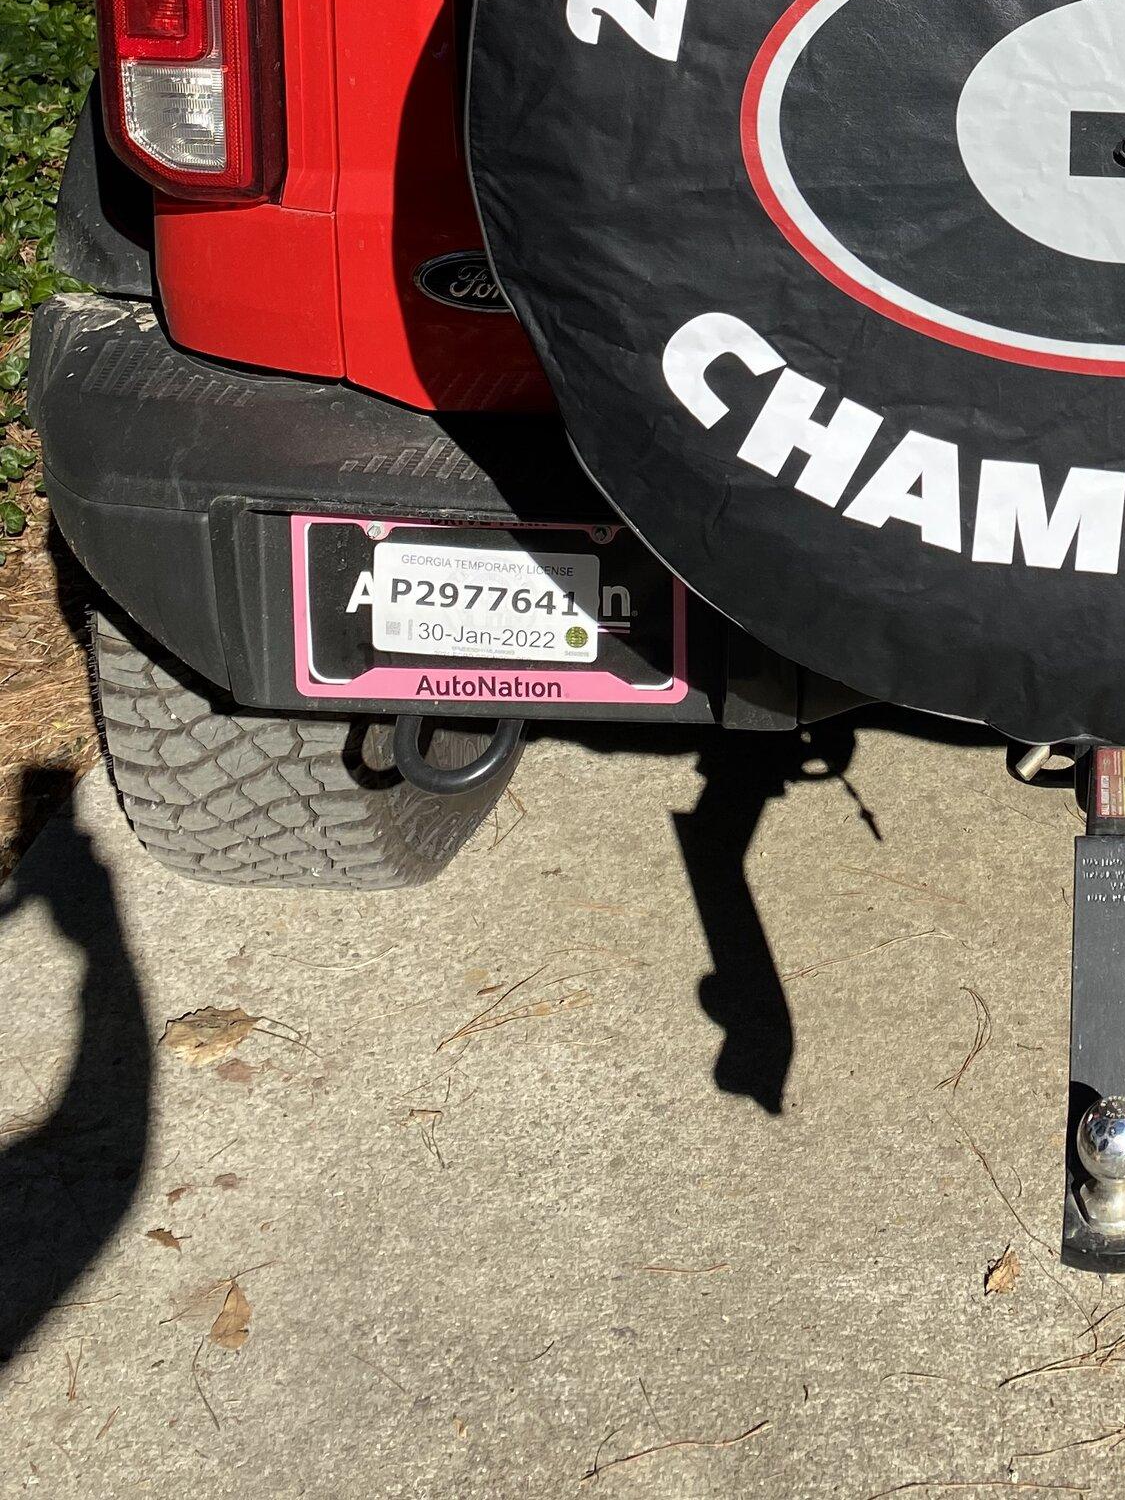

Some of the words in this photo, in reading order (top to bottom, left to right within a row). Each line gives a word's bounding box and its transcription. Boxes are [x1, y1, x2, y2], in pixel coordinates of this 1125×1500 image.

[401, 553, 451, 568] GEORGIA
[455, 559, 524, 575] TEMPORARY
[526, 564, 574, 577] LICENSE
[390, 577, 579, 617] P2977641
[418, 621, 556, 649] 30-Jan-2022
[415, 674, 562, 698] AutoNation
